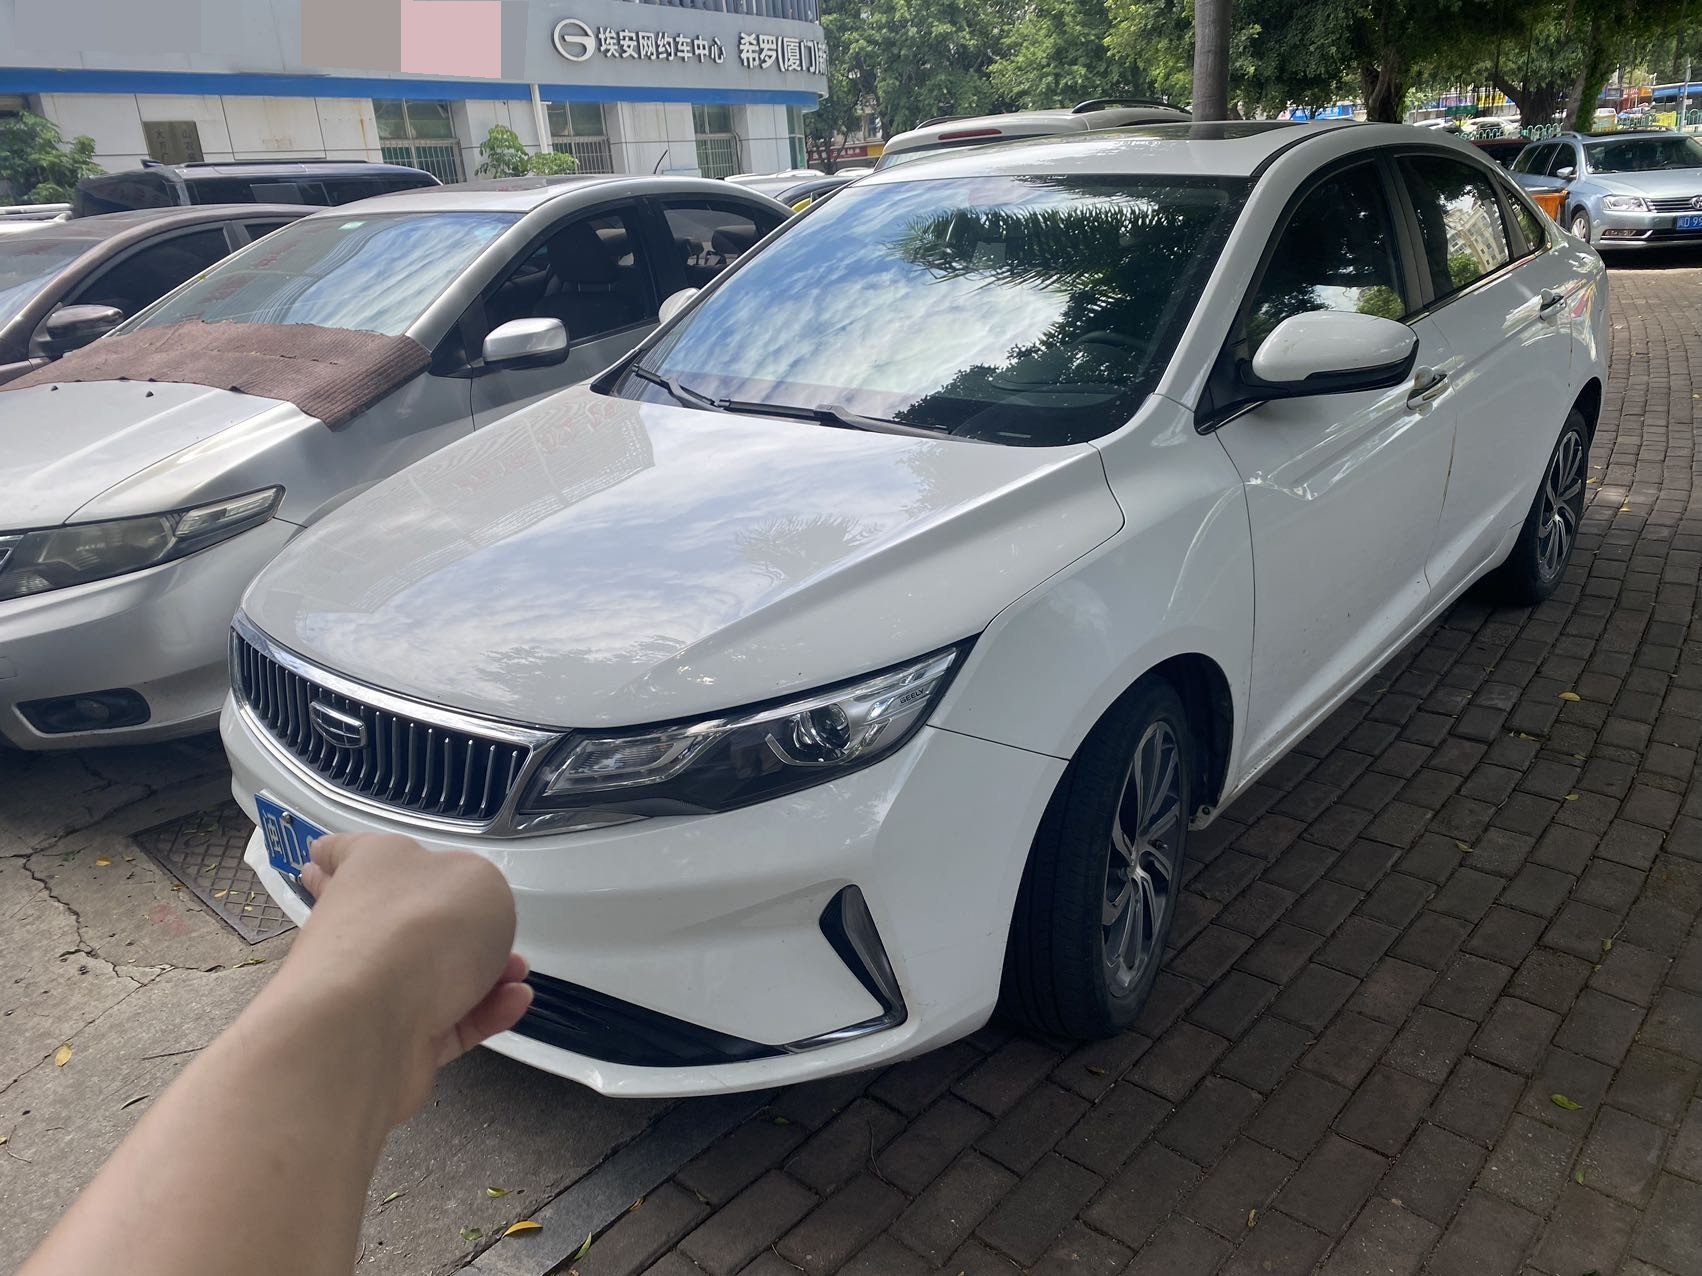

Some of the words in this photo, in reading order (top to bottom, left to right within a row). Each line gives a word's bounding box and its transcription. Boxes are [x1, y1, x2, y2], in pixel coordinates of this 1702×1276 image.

[598, 27, 726, 64] 埃安网约车中心
[900, 688, 924, 703] GEELY
